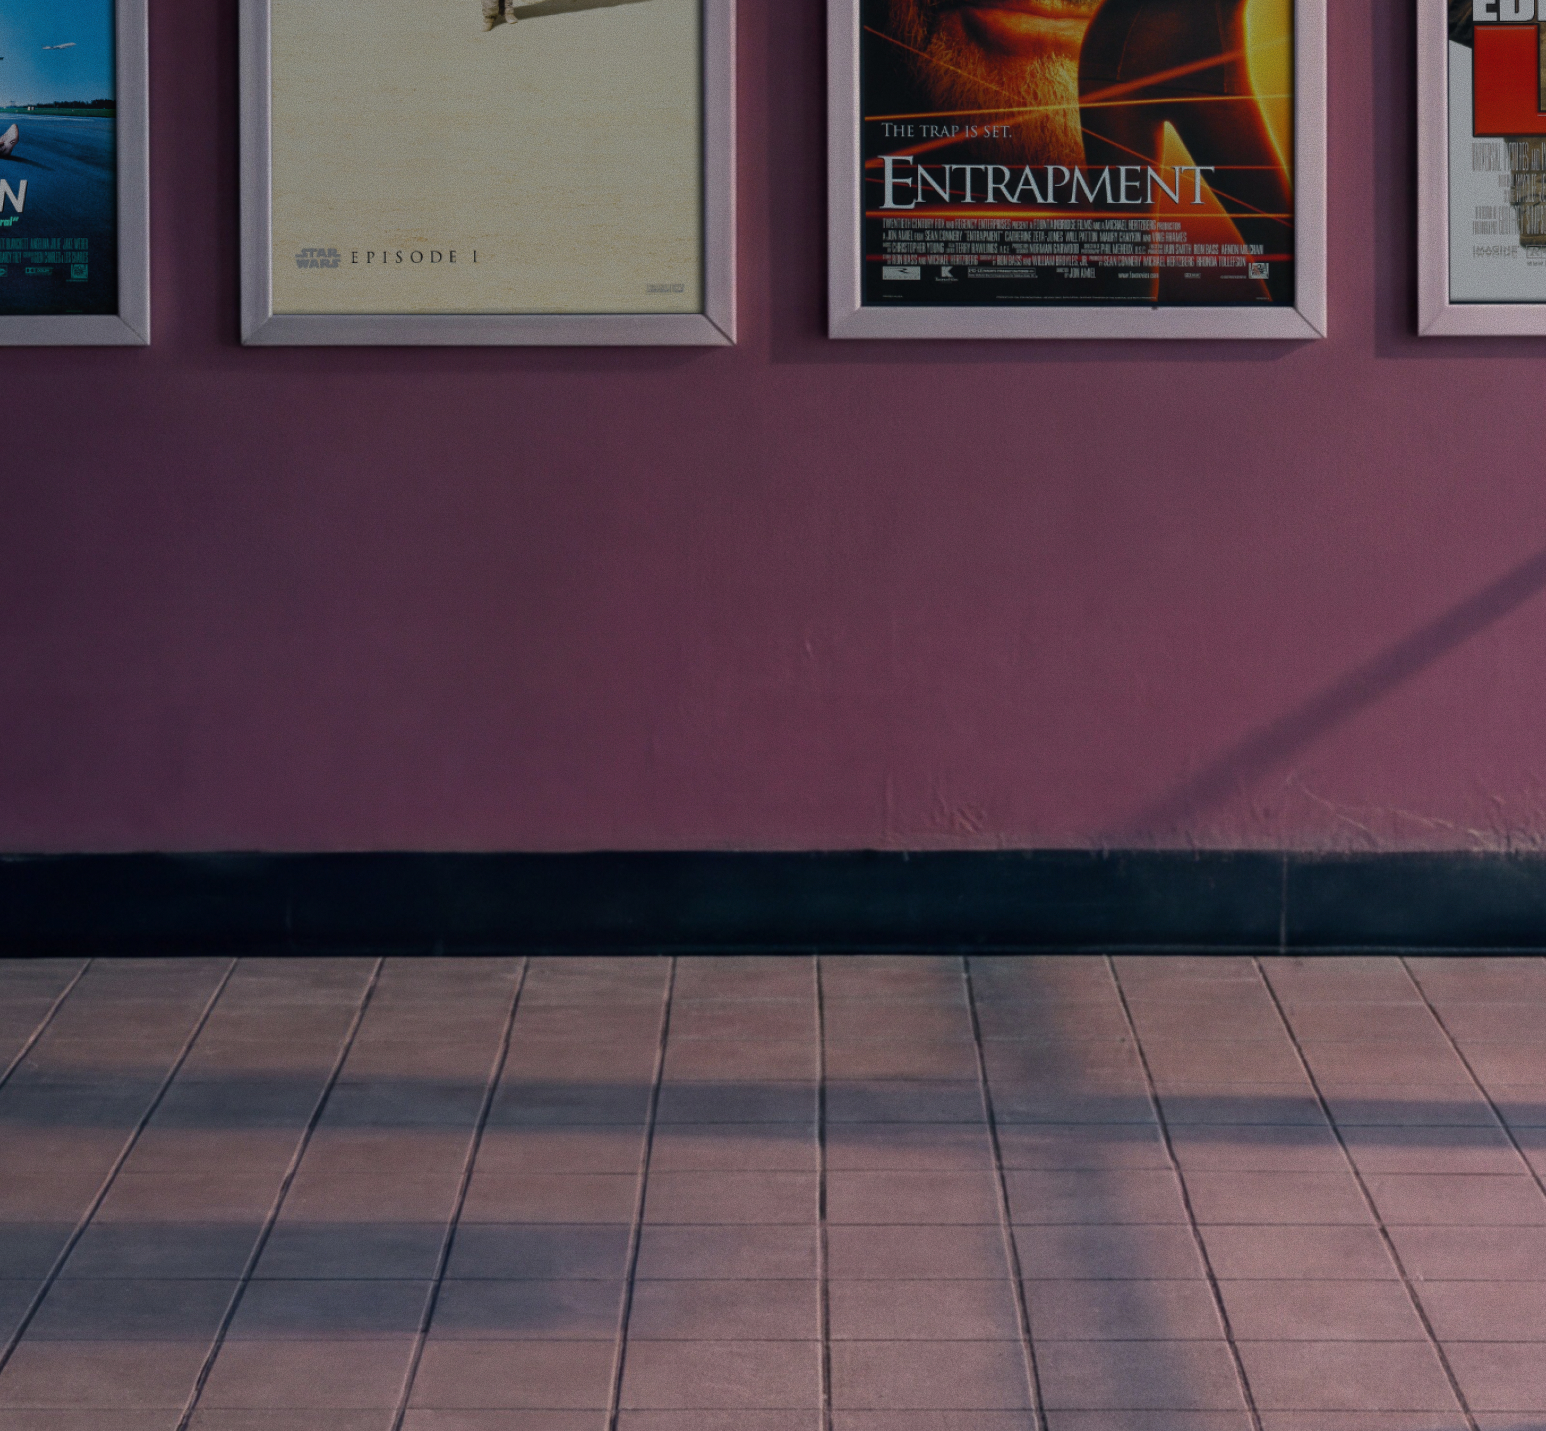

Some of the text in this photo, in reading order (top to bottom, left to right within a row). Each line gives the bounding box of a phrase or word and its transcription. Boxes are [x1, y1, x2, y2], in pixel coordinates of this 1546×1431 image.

[881, 122, 1013, 138] THE TRAP IS SET.
[877, 155, 1215, 210] ENTRAPMENT
[295, 248, 341, 258] STAR
[351, 250, 478, 264] EPISODE I
[296, 257, 341, 269] WARS
